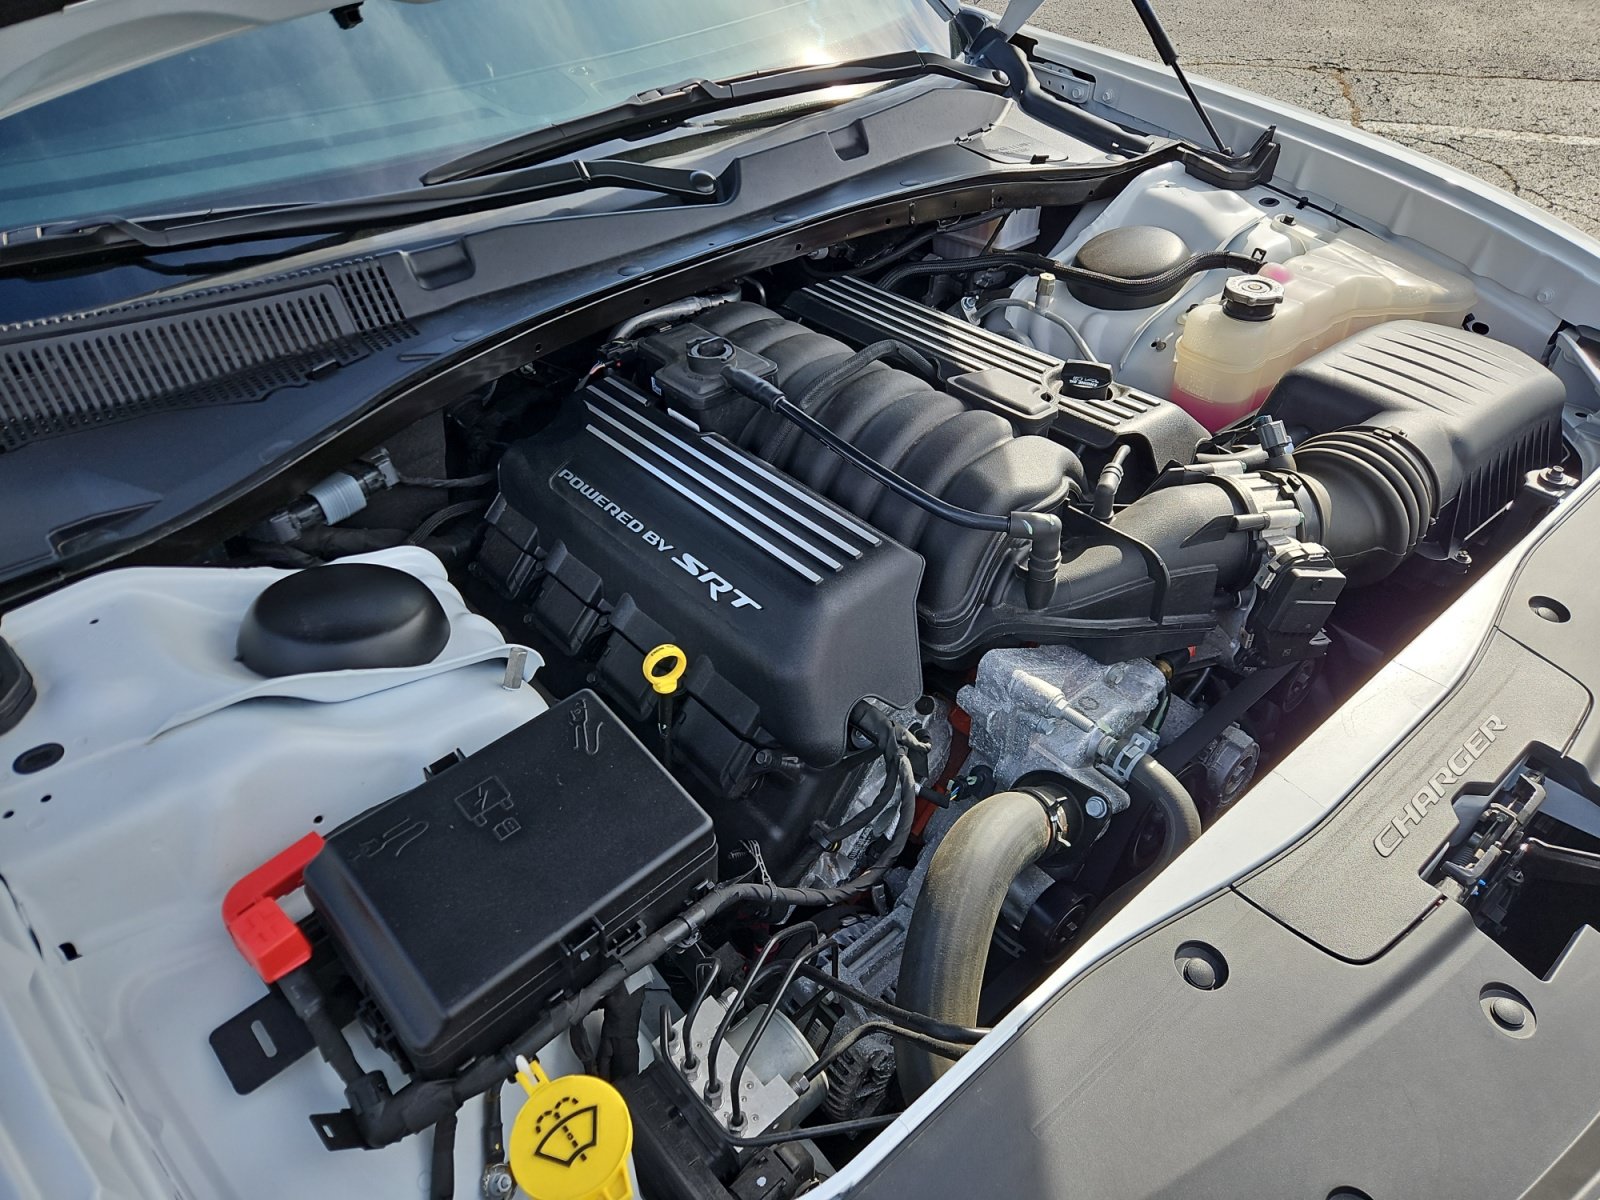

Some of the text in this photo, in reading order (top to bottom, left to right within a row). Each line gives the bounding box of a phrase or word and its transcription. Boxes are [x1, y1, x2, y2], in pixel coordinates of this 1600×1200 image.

[558, 469, 763, 610] POWERED BY SRT
[1373, 715, 1508, 858] CHARGER
